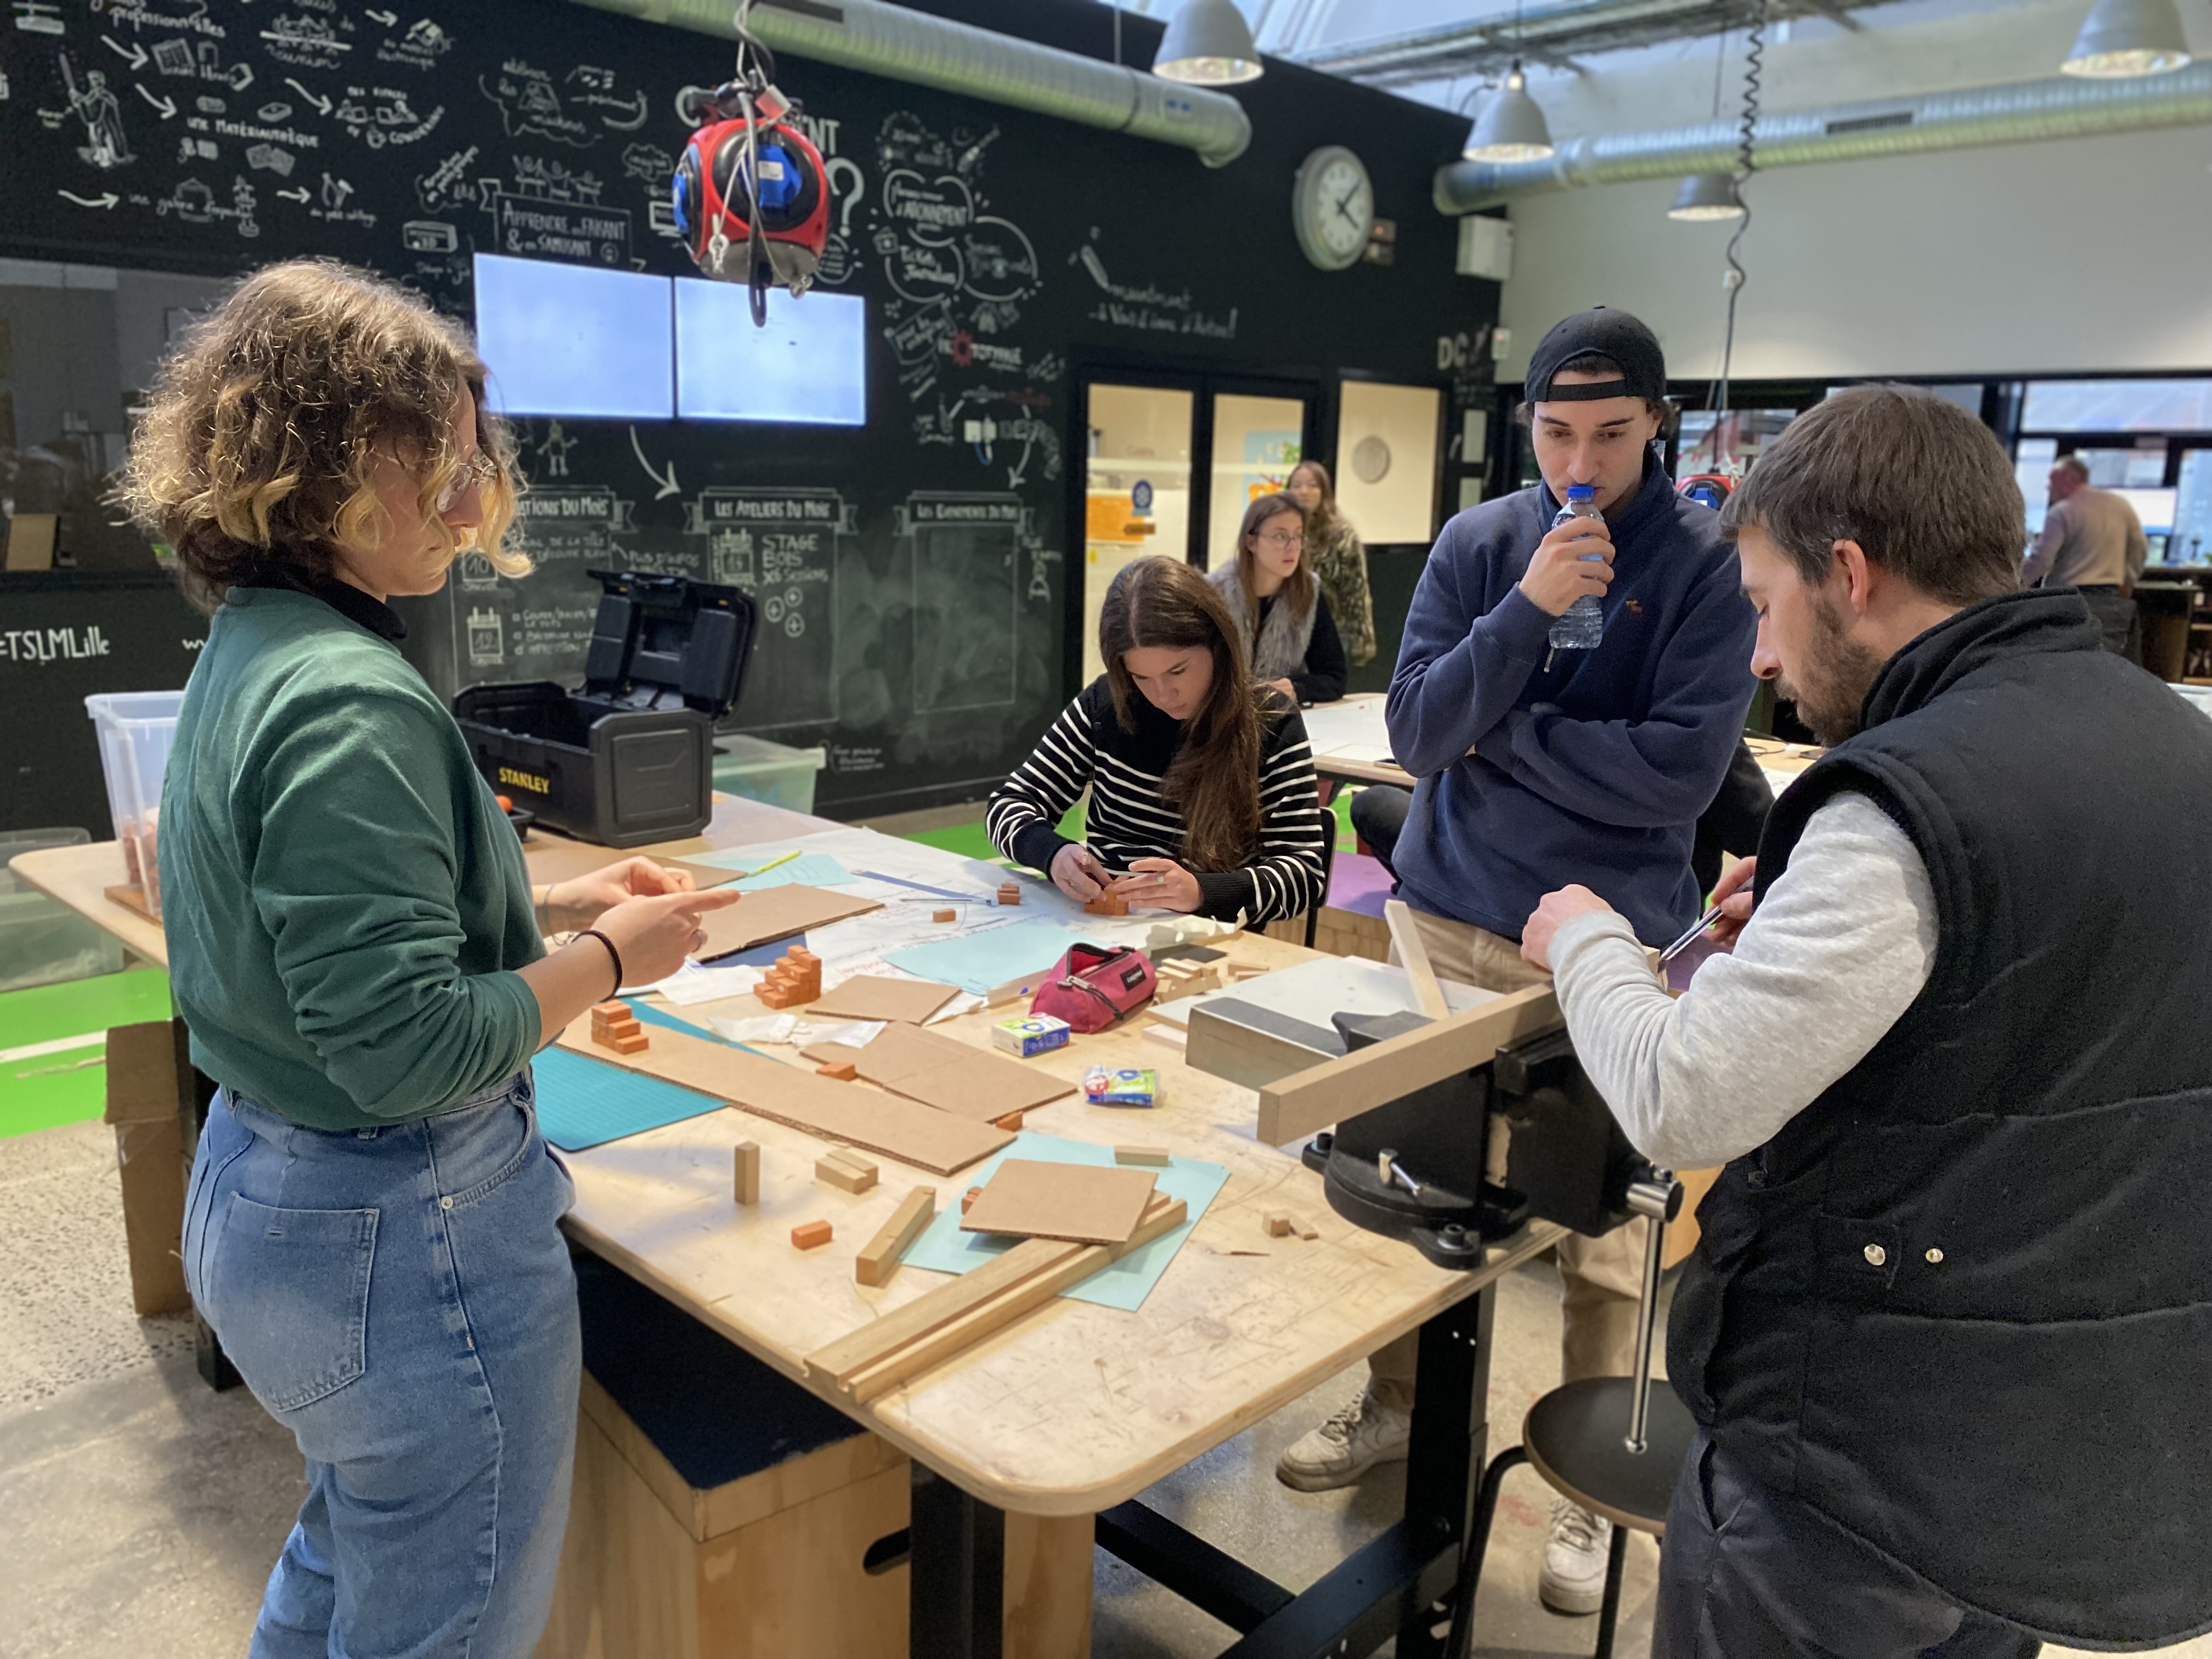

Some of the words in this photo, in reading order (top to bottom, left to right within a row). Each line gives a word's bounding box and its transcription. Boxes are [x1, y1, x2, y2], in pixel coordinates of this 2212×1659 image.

[761, 533, 819, 552] STAGE
[762, 550, 803, 569] BOIS
[499, 768, 550, 794] STANLEY
